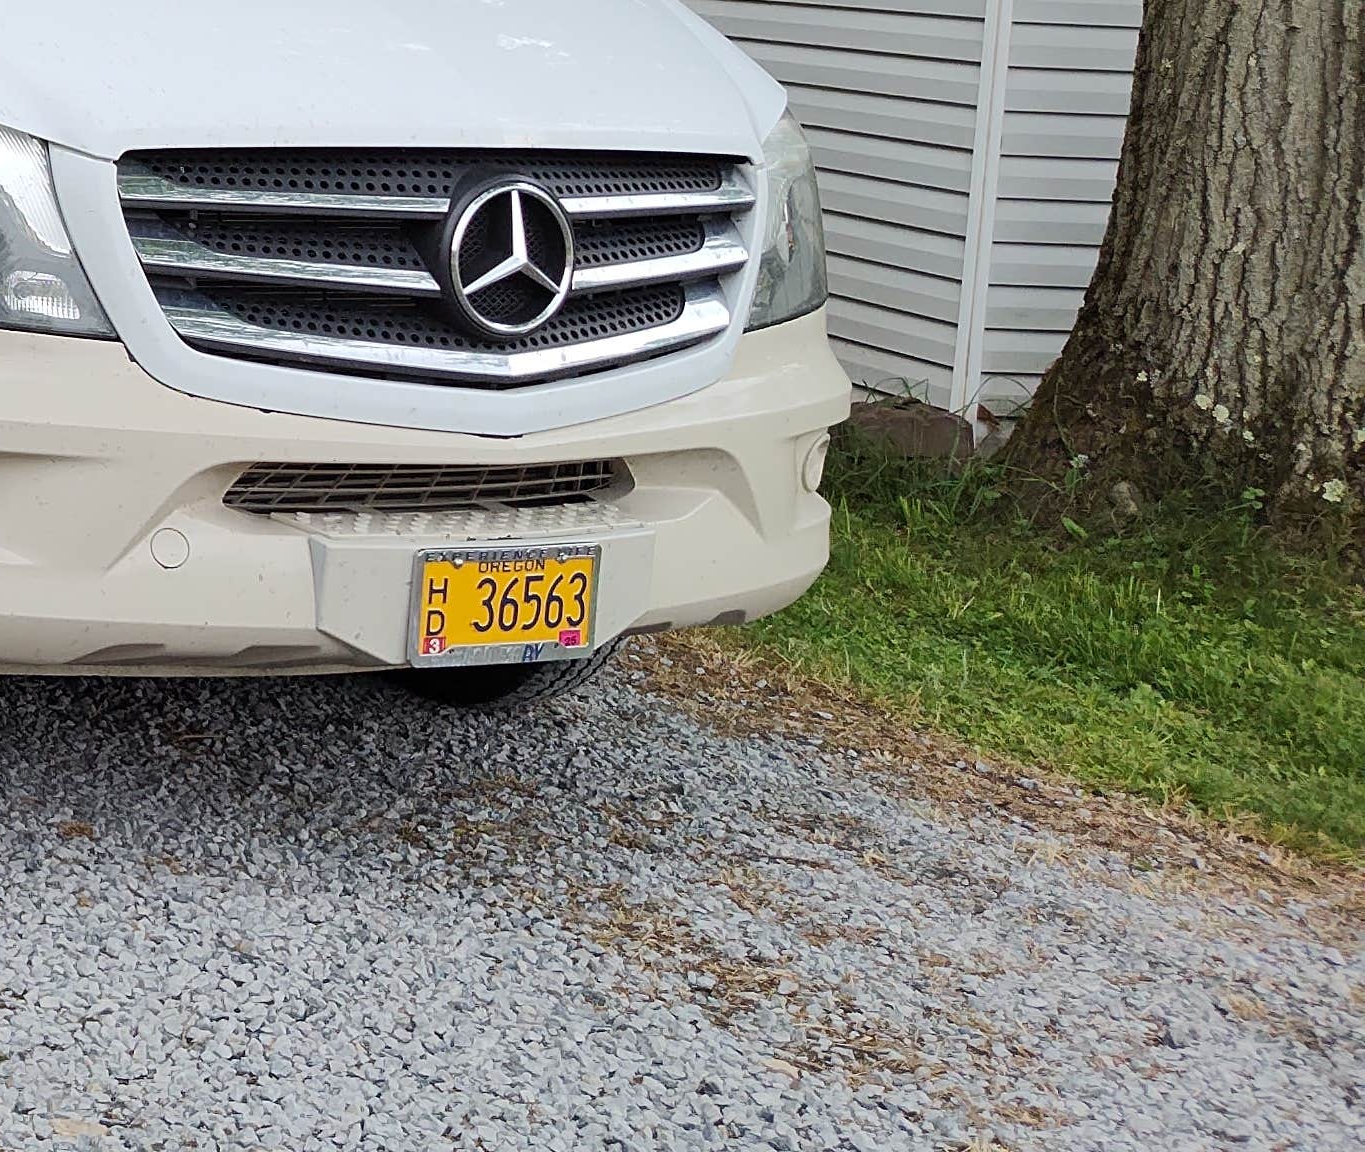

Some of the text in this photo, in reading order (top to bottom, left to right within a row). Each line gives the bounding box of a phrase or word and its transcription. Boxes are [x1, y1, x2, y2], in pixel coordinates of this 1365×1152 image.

[478, 559, 546, 574] OREGON
[472, 572, 588, 633] 36563
[428, 638, 441, 654] 3
